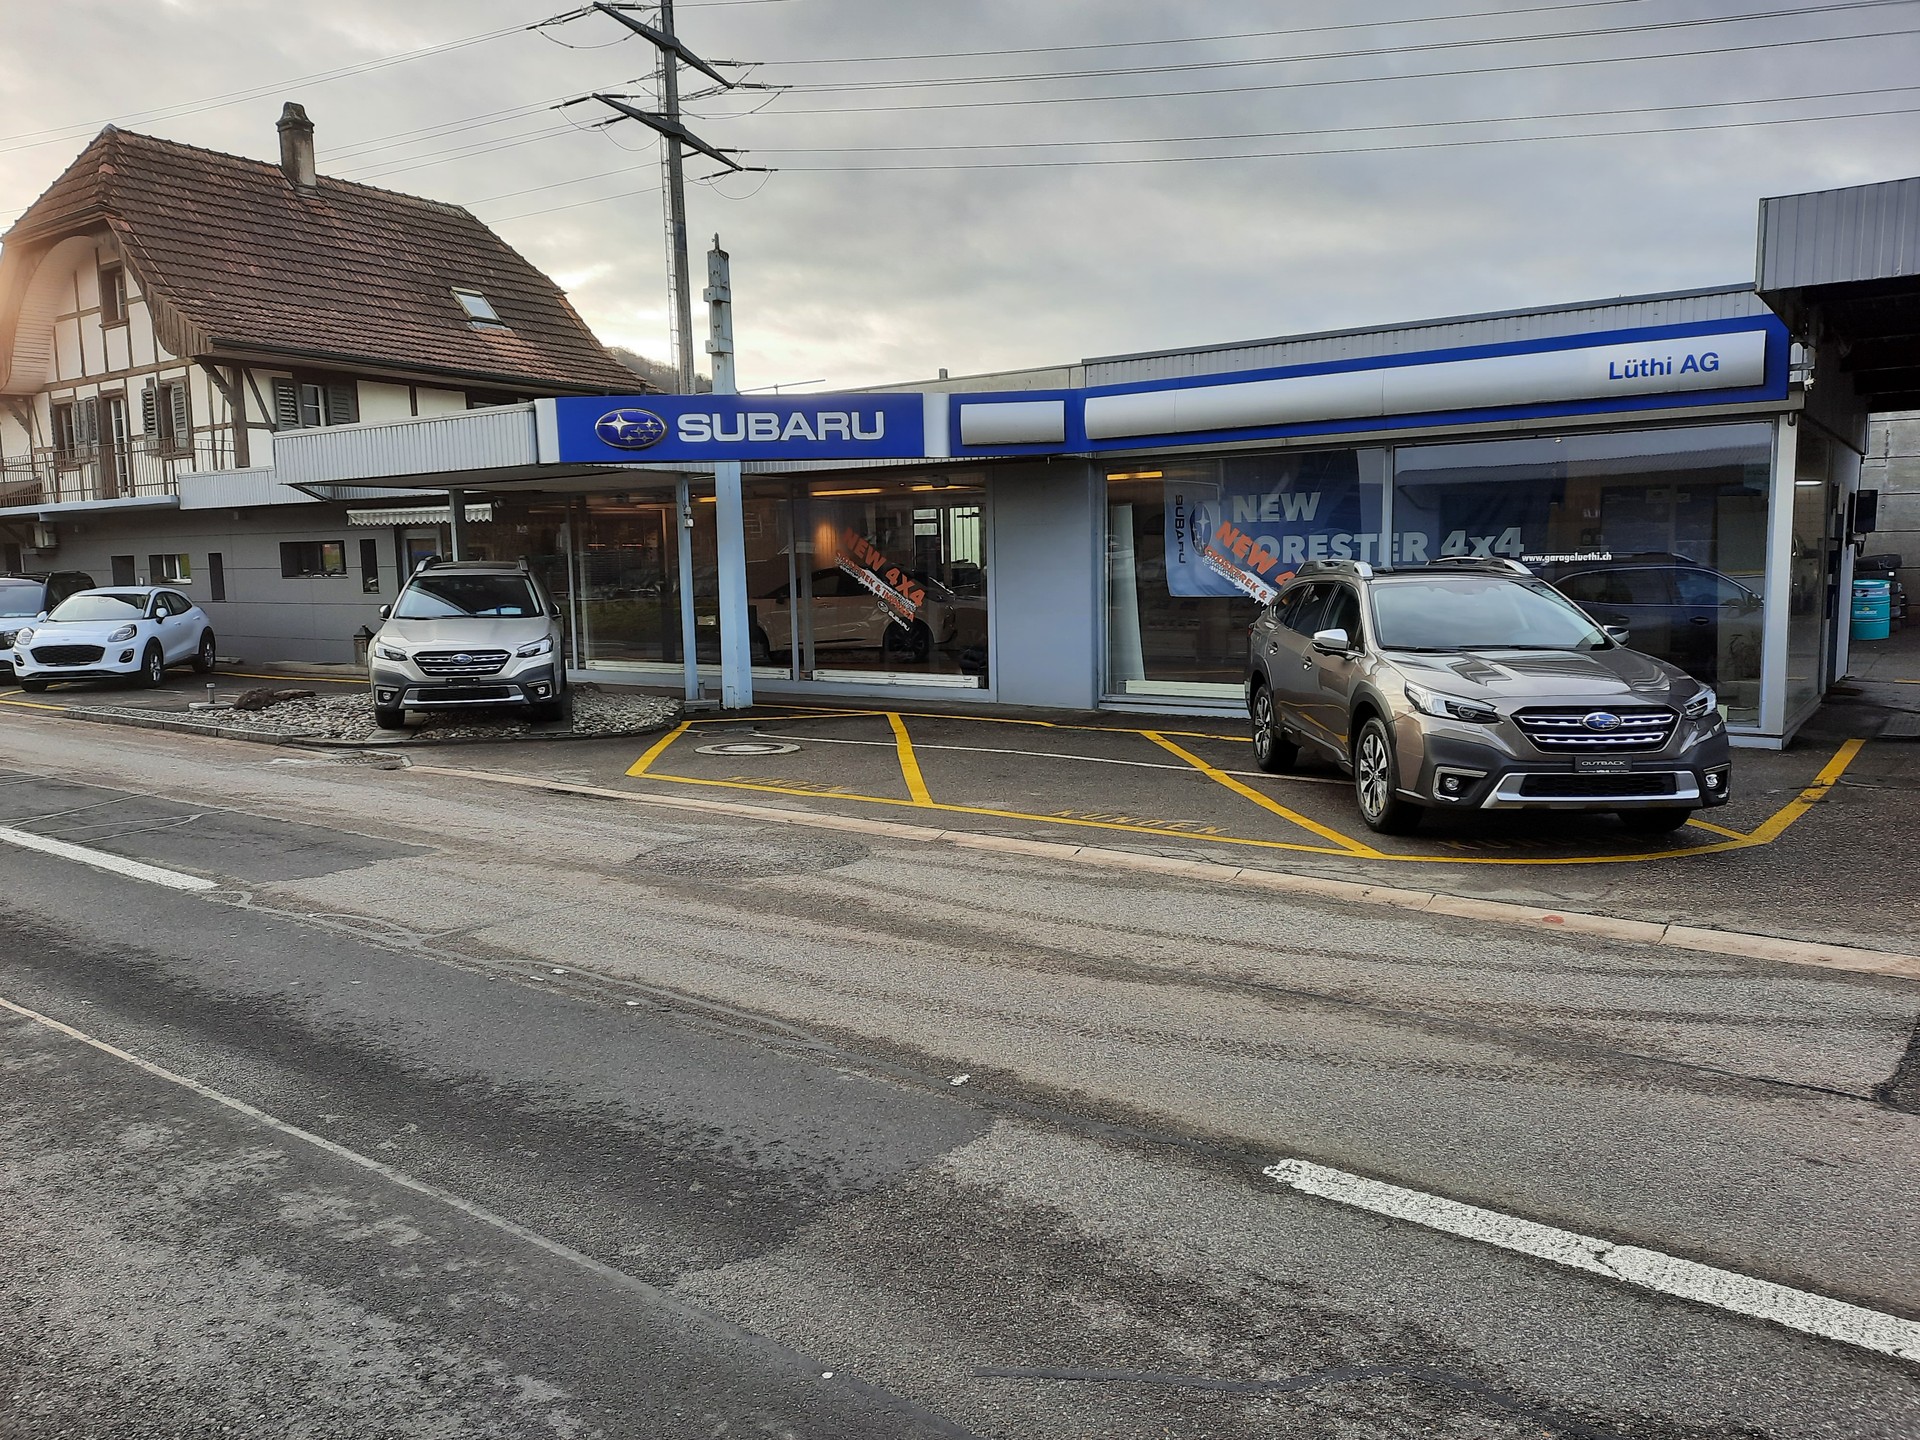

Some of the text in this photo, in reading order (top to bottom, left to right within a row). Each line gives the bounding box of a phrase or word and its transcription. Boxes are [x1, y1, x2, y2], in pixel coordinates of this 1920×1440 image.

[1609, 352, 1719, 380] Lüthi AG
[677, 411, 885, 442] SUBARU
[1233, 491, 1321, 523] NEW
[1175, 494, 1187, 564] SUBARU
[1440, 526, 1526, 558] 4x4
[1215, 519, 1278, 575] NEW
[1521, 552, 1612, 564] www.garageluethi.ch
[843, 527, 926, 607] NEW 4X4
[887, 610, 910, 632] SUBARU
[1050, 808, 1230, 835] KUNDEN
